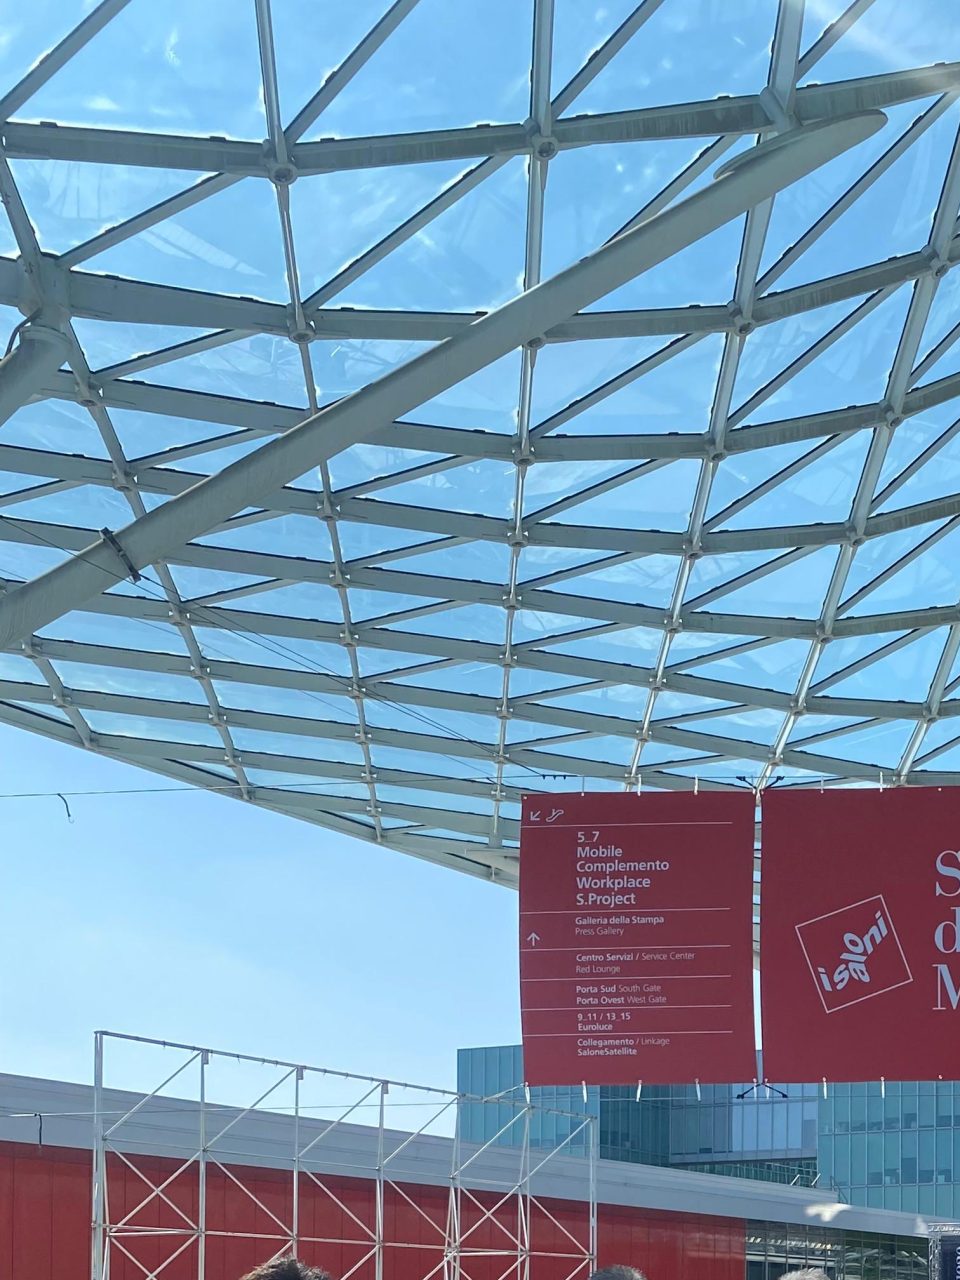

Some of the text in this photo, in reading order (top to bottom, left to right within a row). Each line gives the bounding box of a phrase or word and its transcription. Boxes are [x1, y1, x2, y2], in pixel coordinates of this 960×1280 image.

[577, 831, 600, 843] 5_7
[576, 846, 623, 858] Mobile
[576, 860, 670, 874] Complemento
[576, 876, 651, 890] Workplace
[576, 892, 636, 907] S.Project
[575, 915, 664, 925] Galleria della Stampa
[575, 926, 624, 936] Press Gallery
[576, 953, 604, 962] Centro
[641, 952, 668, 961] Service
[669, 951, 695, 960] Center
[576, 964, 621, 975] Red Lounge
[576, 984, 661, 994] Porta Sud South Gate
[576, 996, 598, 1005] Porta
[600, 995, 625, 1004] Ovest
[648, 995, 667, 1003] Gate
[577, 1022, 613, 1031] Euroluce
[577, 1038, 635, 1048] Collegamento
[641, 1037, 670, 1047] Linkage
[577, 1048, 637, 1056] SaloneSatellite
